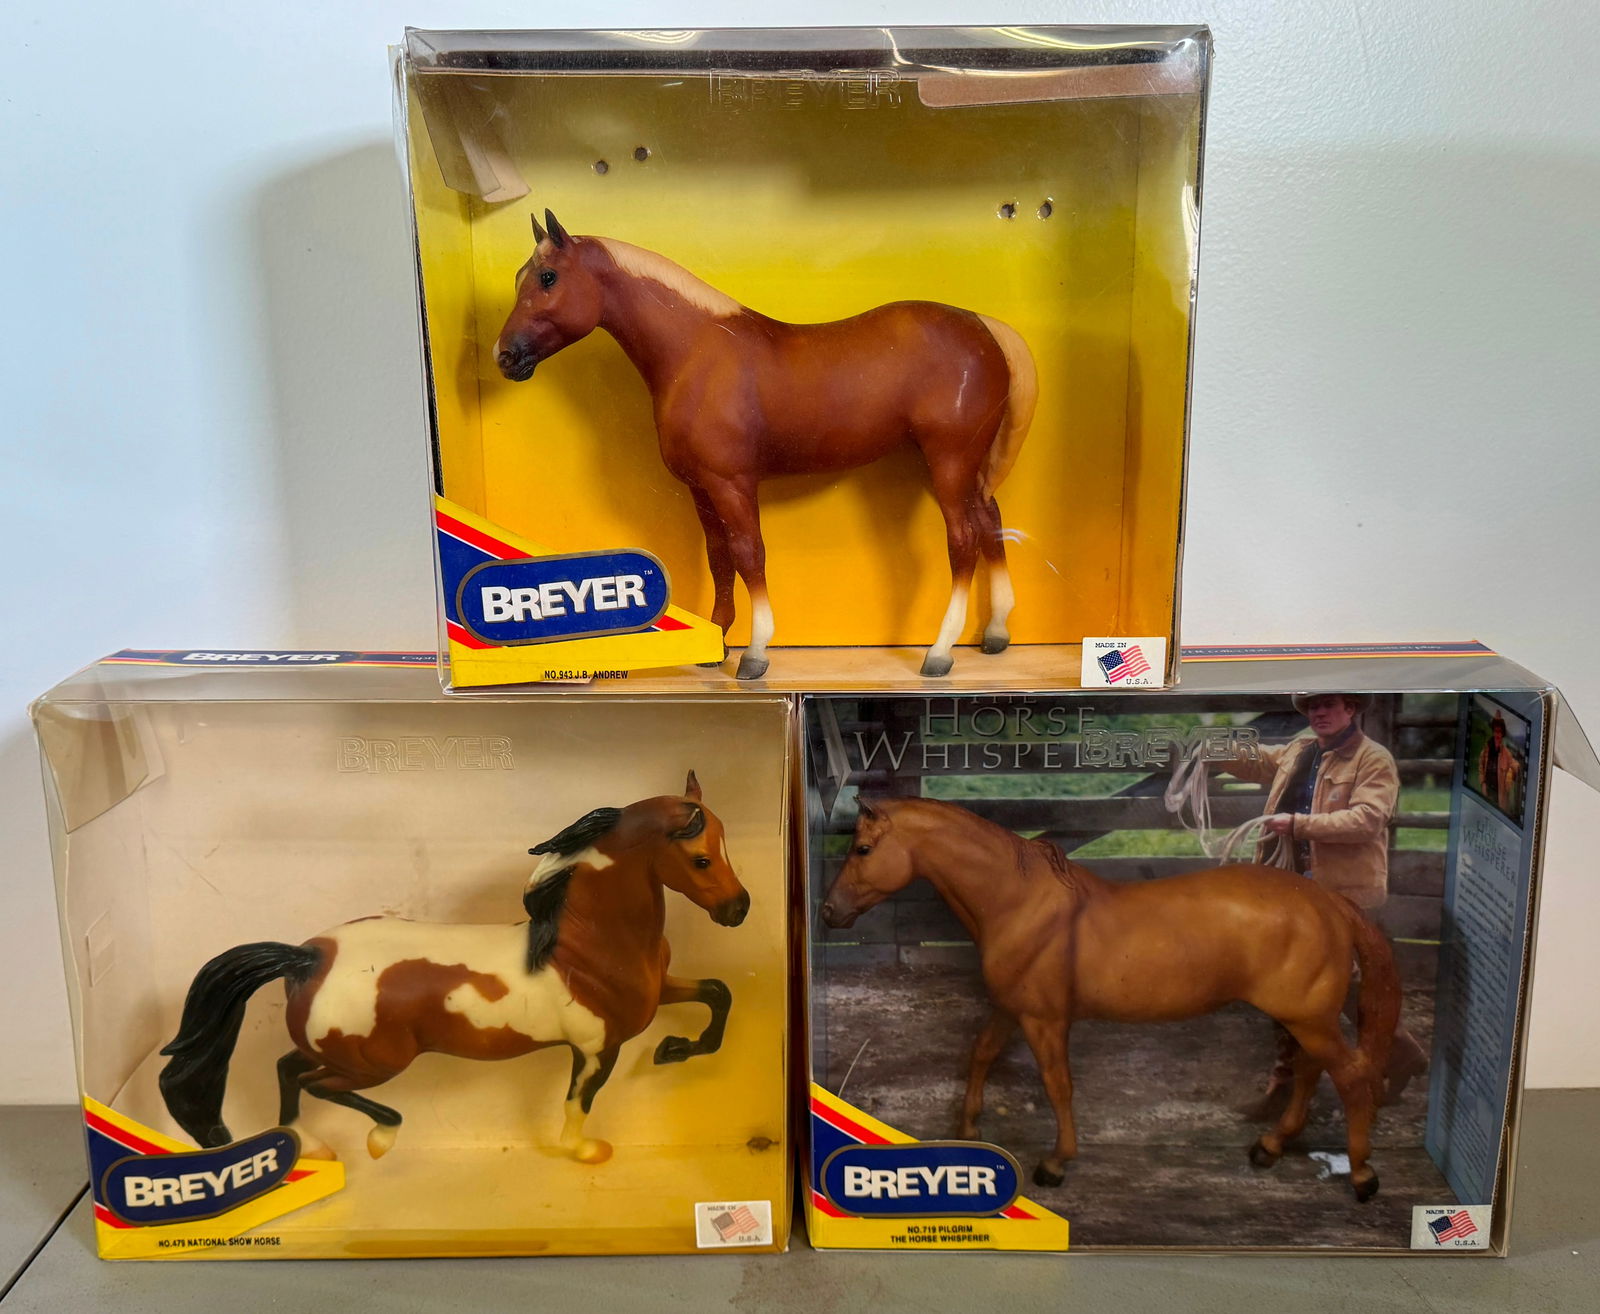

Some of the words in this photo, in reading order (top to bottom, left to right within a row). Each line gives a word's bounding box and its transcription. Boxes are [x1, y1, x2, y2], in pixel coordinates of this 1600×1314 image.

[481, 574, 649, 623] BREYER
[182, 652, 341, 662] BREYER
[544, 670, 573, 680] NO.943
[574, 670, 591, 679] J.B.
[593, 670, 629, 679] ANDREW
[336, 735, 515, 774] BREYER
[1081, 726, 1263, 767] BREYER
[124, 1148, 279, 1207] BREYER
[844, 1165, 997, 1198] BREYER
[890, 1235, 907, 1243] THE
[909, 1234, 938, 1243] HORSE
[940, 1234, 990, 1243] WHISPERER
[938, 1225, 973, 1233] PILGRIM
[187, 1238, 226, 1246] NATIONAL
[228, 1237, 252, 1246] SHOW
[254, 1236, 280, 1246] HORSE
